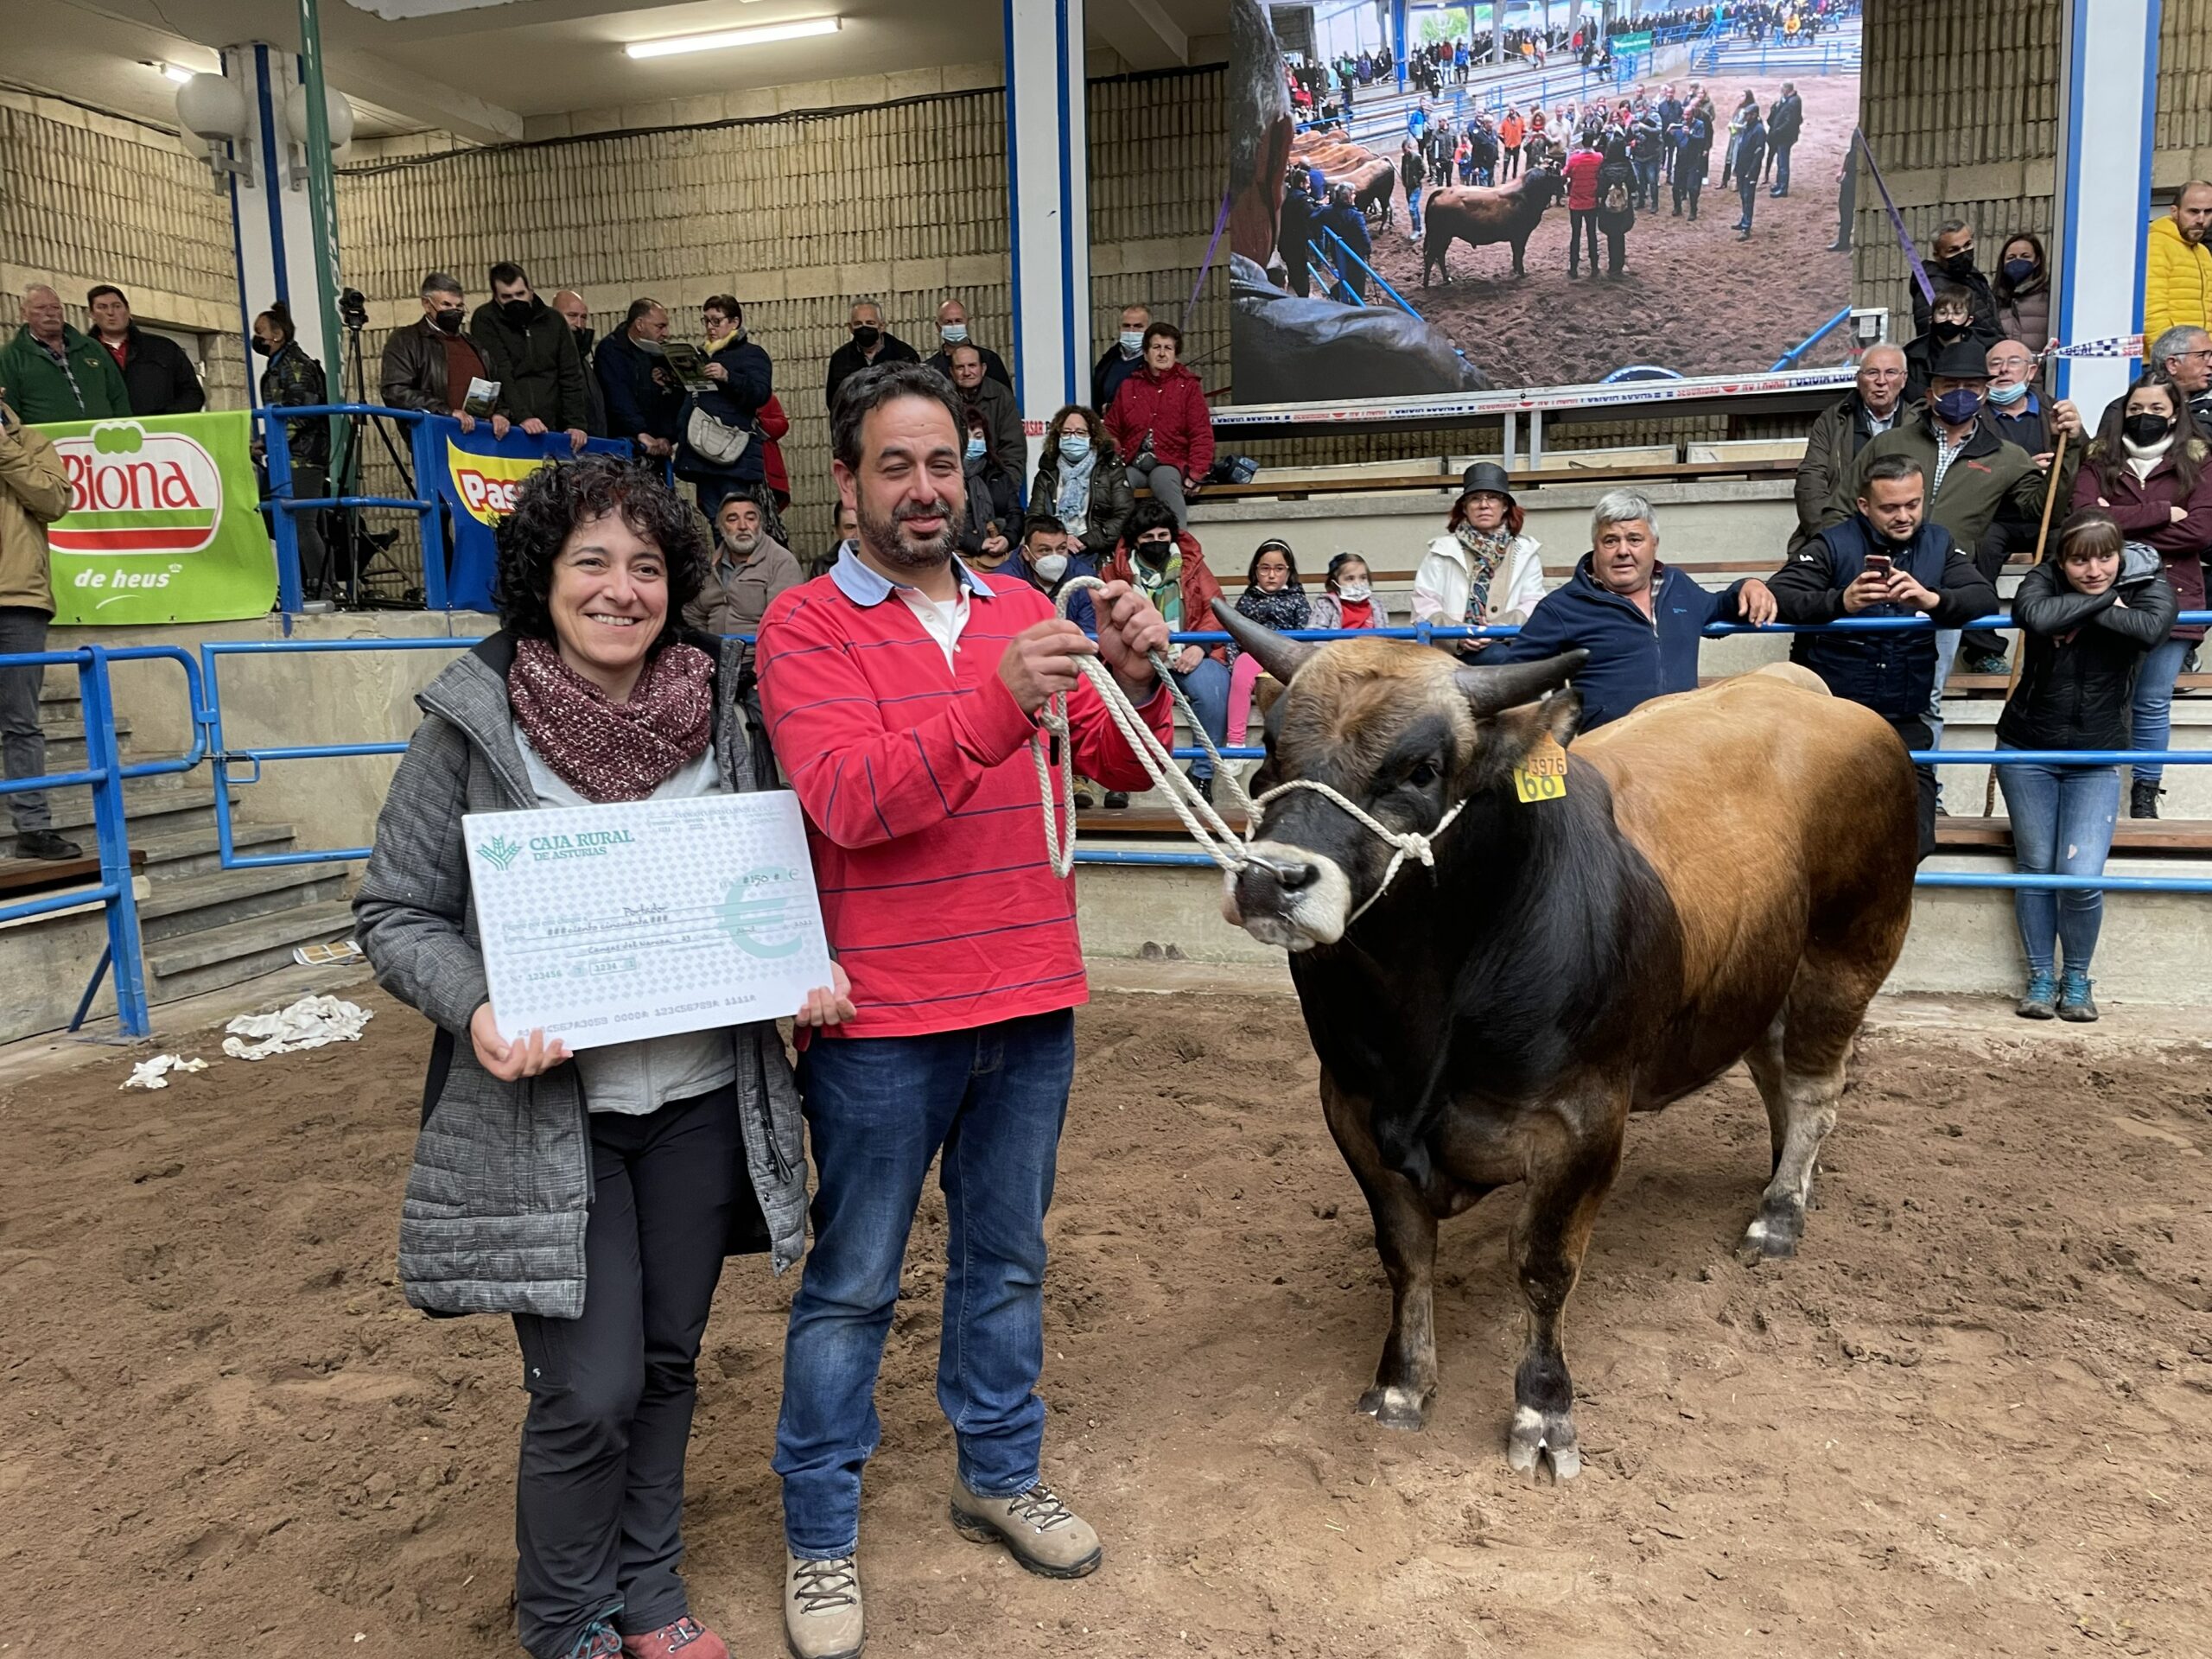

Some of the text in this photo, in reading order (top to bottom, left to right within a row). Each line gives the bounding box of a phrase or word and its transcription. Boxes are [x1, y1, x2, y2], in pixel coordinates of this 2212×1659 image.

[60, 454, 201, 511] Biona
[461, 473, 518, 511] Pas
[74, 569, 169, 588] de heus
[1531, 758, 1564, 774] 3976
[529, 830, 635, 851] CAJA RURAL
[534, 847, 607, 861] DE ASTURIAS
